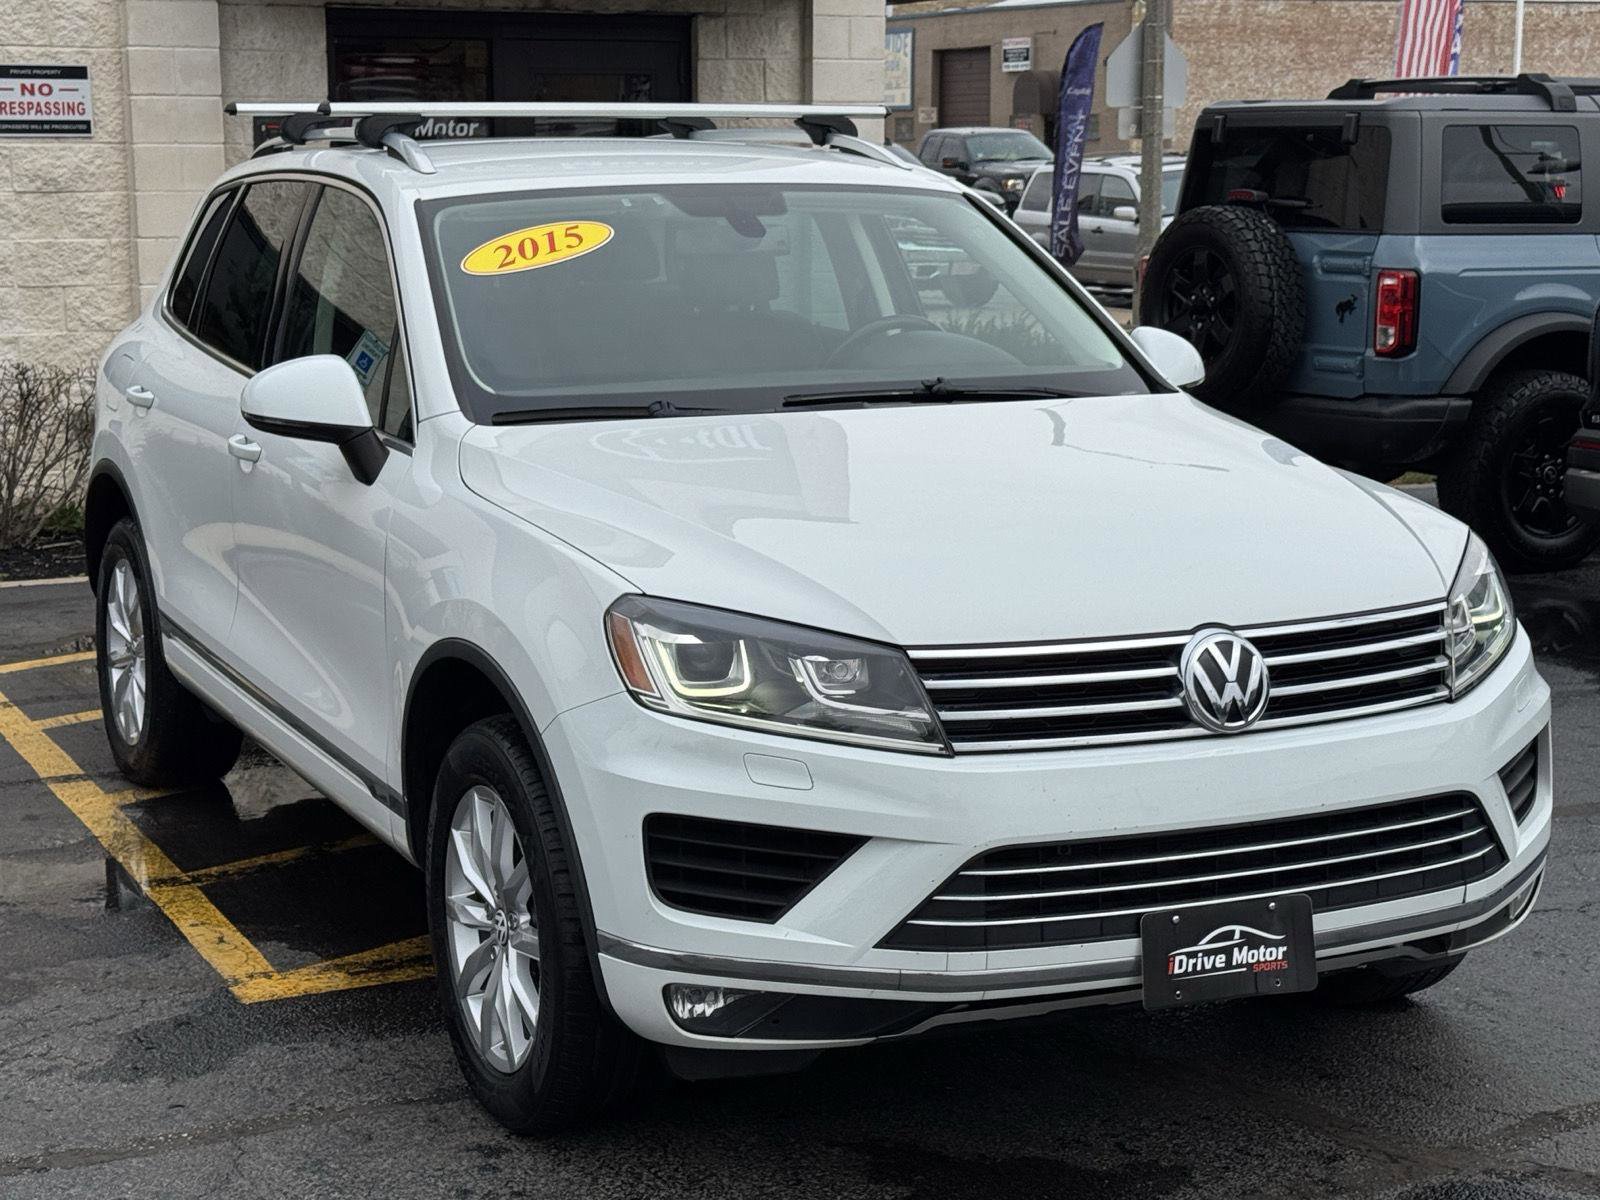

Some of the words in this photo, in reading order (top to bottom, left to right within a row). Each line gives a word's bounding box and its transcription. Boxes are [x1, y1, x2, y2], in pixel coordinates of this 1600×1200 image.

[20, 83, 53, 96] NO
[415, 118, 479, 137] Motor
[1056, 198, 1073, 258] SALE
[494, 225, 584, 269] 2015
[1167, 951, 1226, 975] iDrive
[1232, 945, 1288, 965] Motor
[1252, 960, 1288, 973] SPORTS
